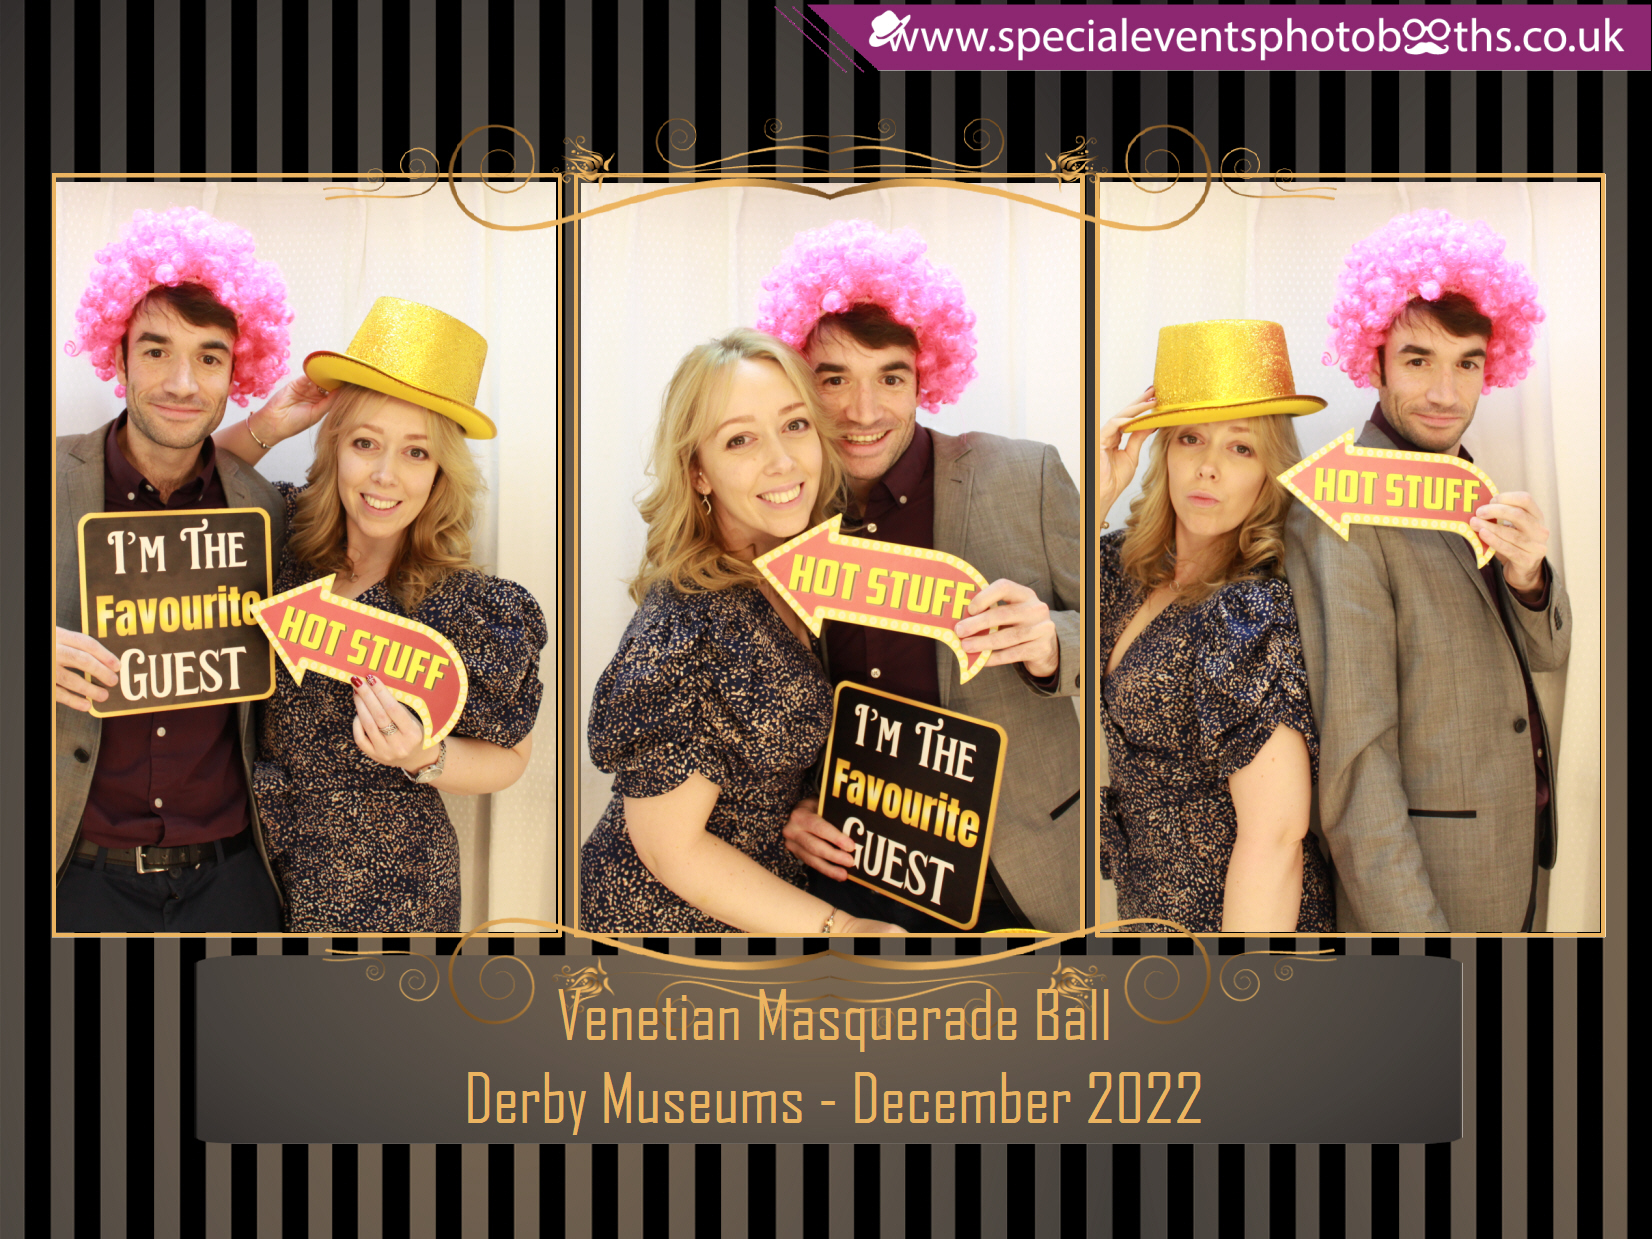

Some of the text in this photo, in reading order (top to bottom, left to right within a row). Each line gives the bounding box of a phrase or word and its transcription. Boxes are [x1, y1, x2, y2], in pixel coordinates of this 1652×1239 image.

[1314, 467, 1481, 513] HOT STUFF
[180, 519, 247, 570] THE
[96, 585, 261, 638] Favourite
[788, 554, 975, 620] HOT STUFF
[119, 646, 247, 701] GUEST
[278, 605, 450, 690] HOT STUFF
[915, 718, 977, 783] THE
[831, 757, 980, 848] Favourite
